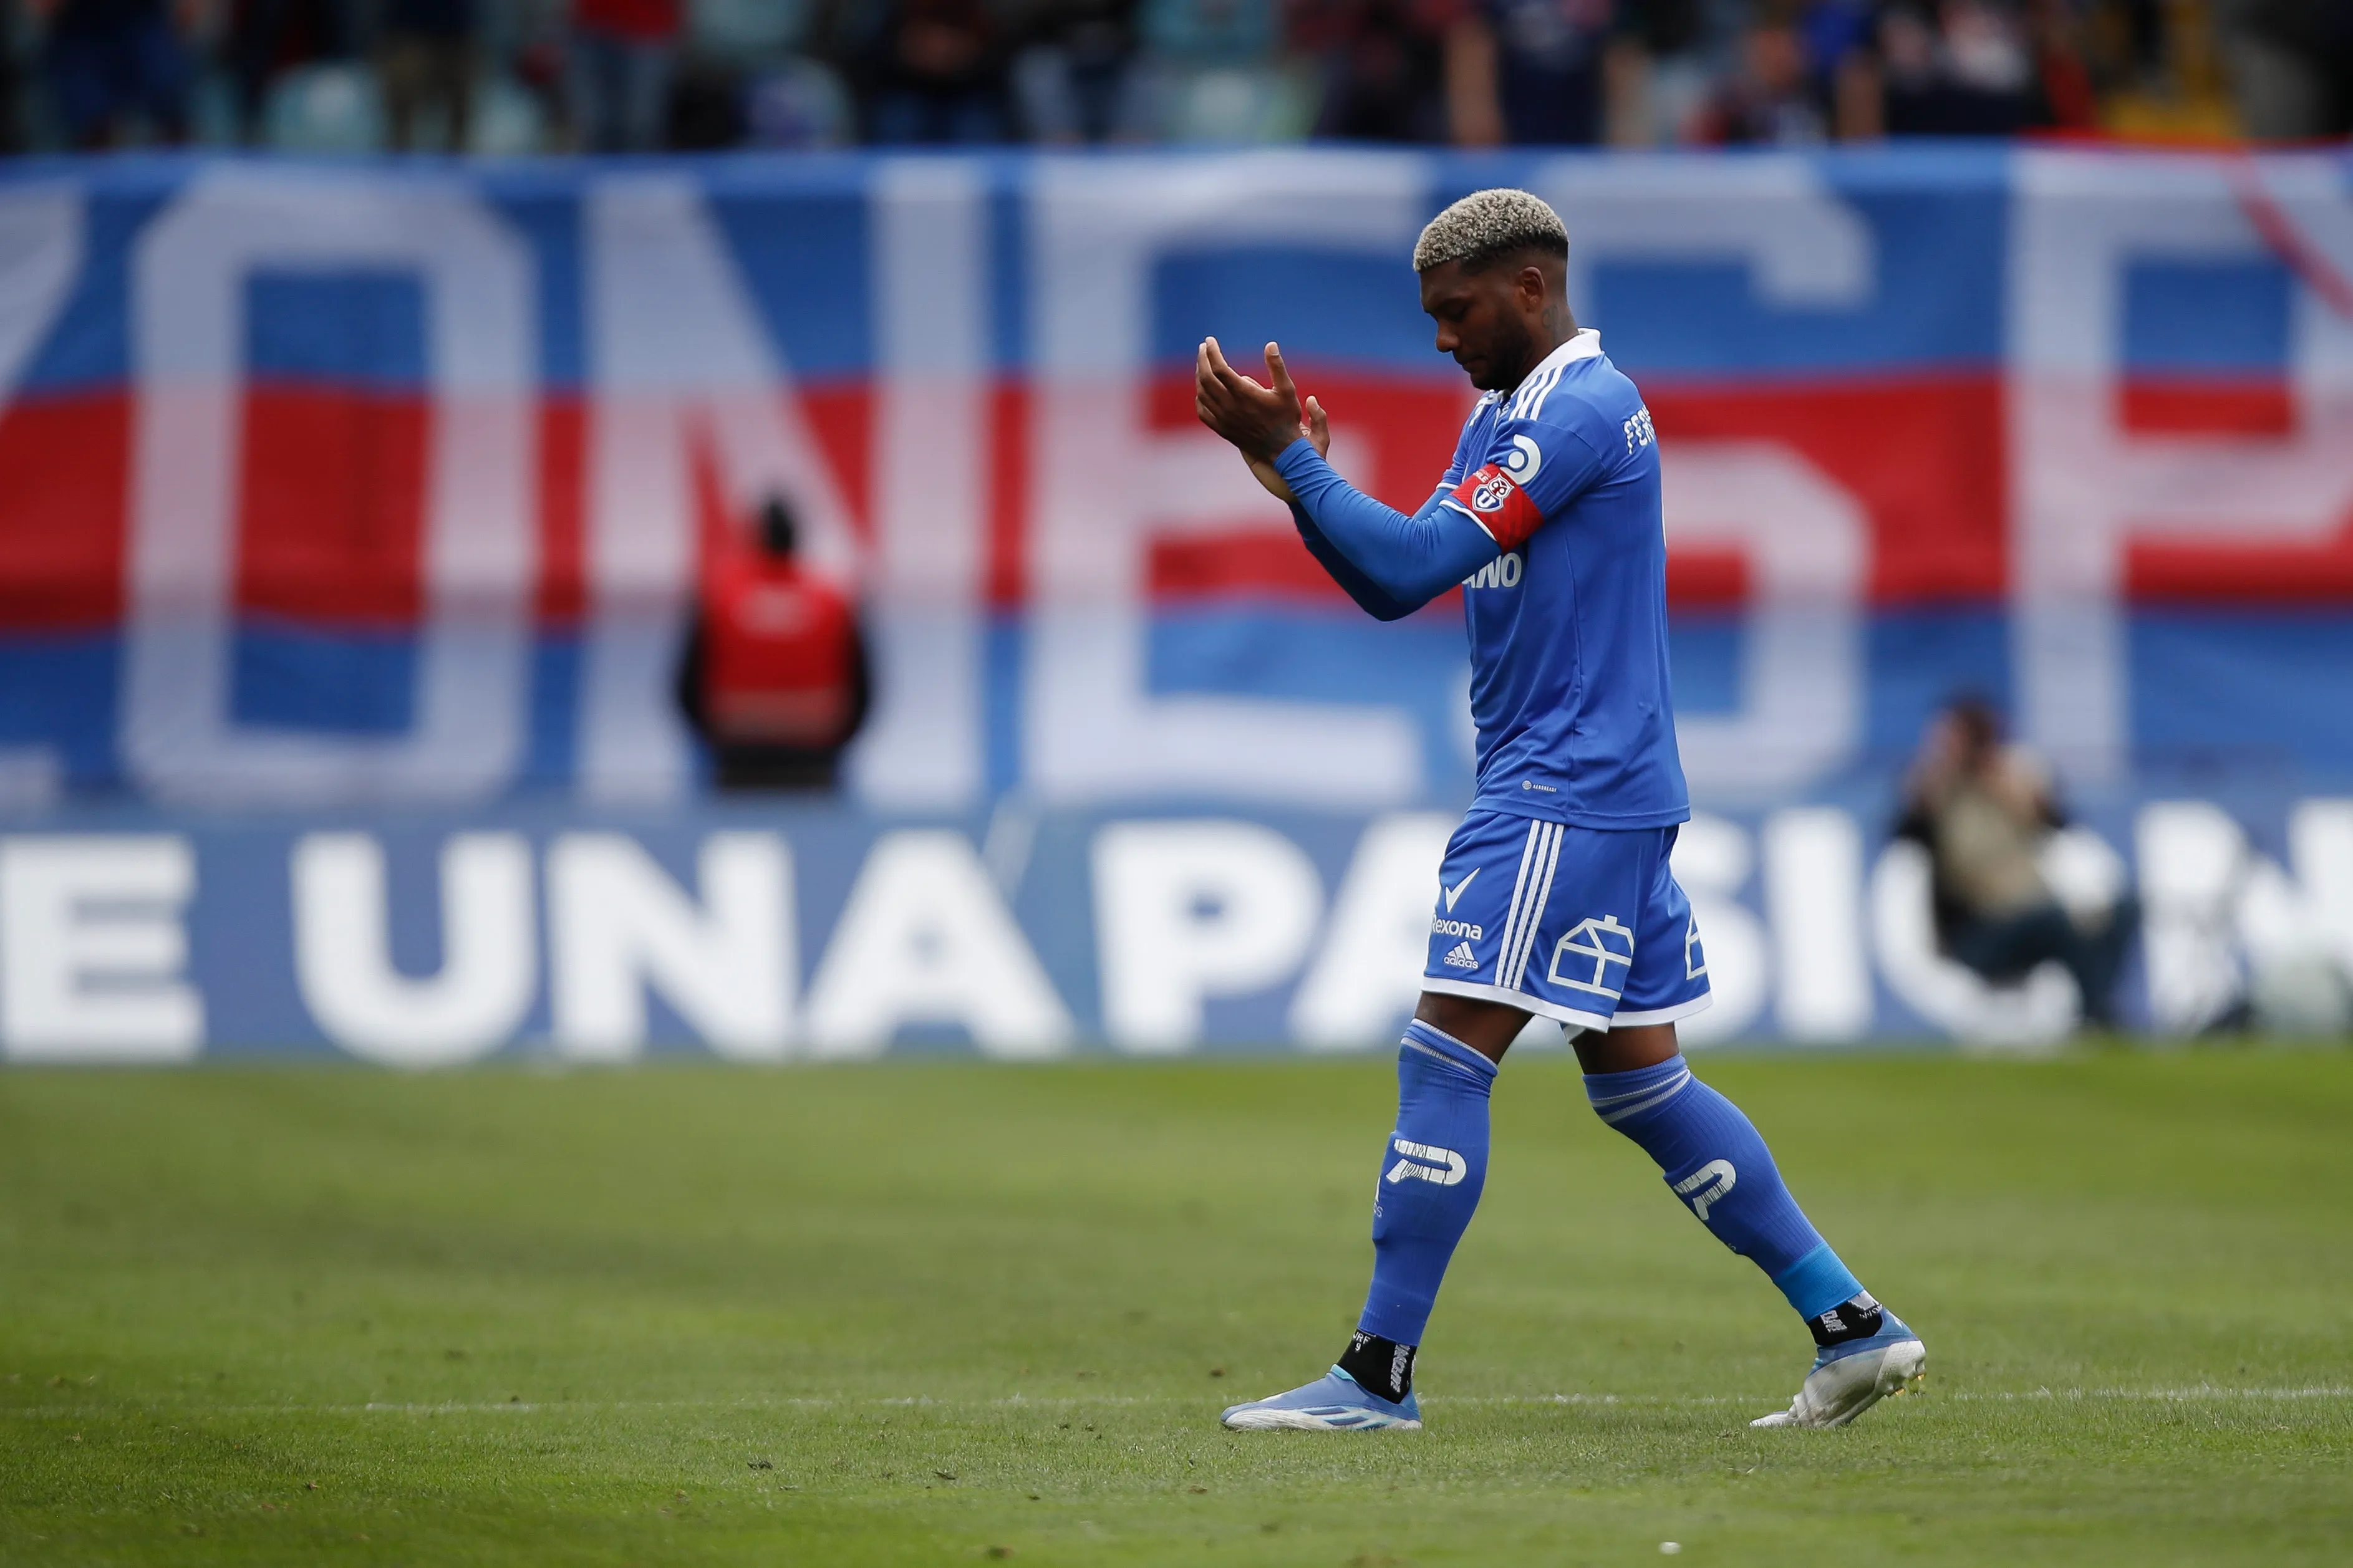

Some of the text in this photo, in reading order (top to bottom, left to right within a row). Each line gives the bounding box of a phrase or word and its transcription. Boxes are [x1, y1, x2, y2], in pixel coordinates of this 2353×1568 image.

[0, 157, 1868, 810] ONES
[290, 828, 1076, 1067] UNA
[1443, 955, 1479, 969] adidas
[1355, 1342, 1362, 1352] 9
